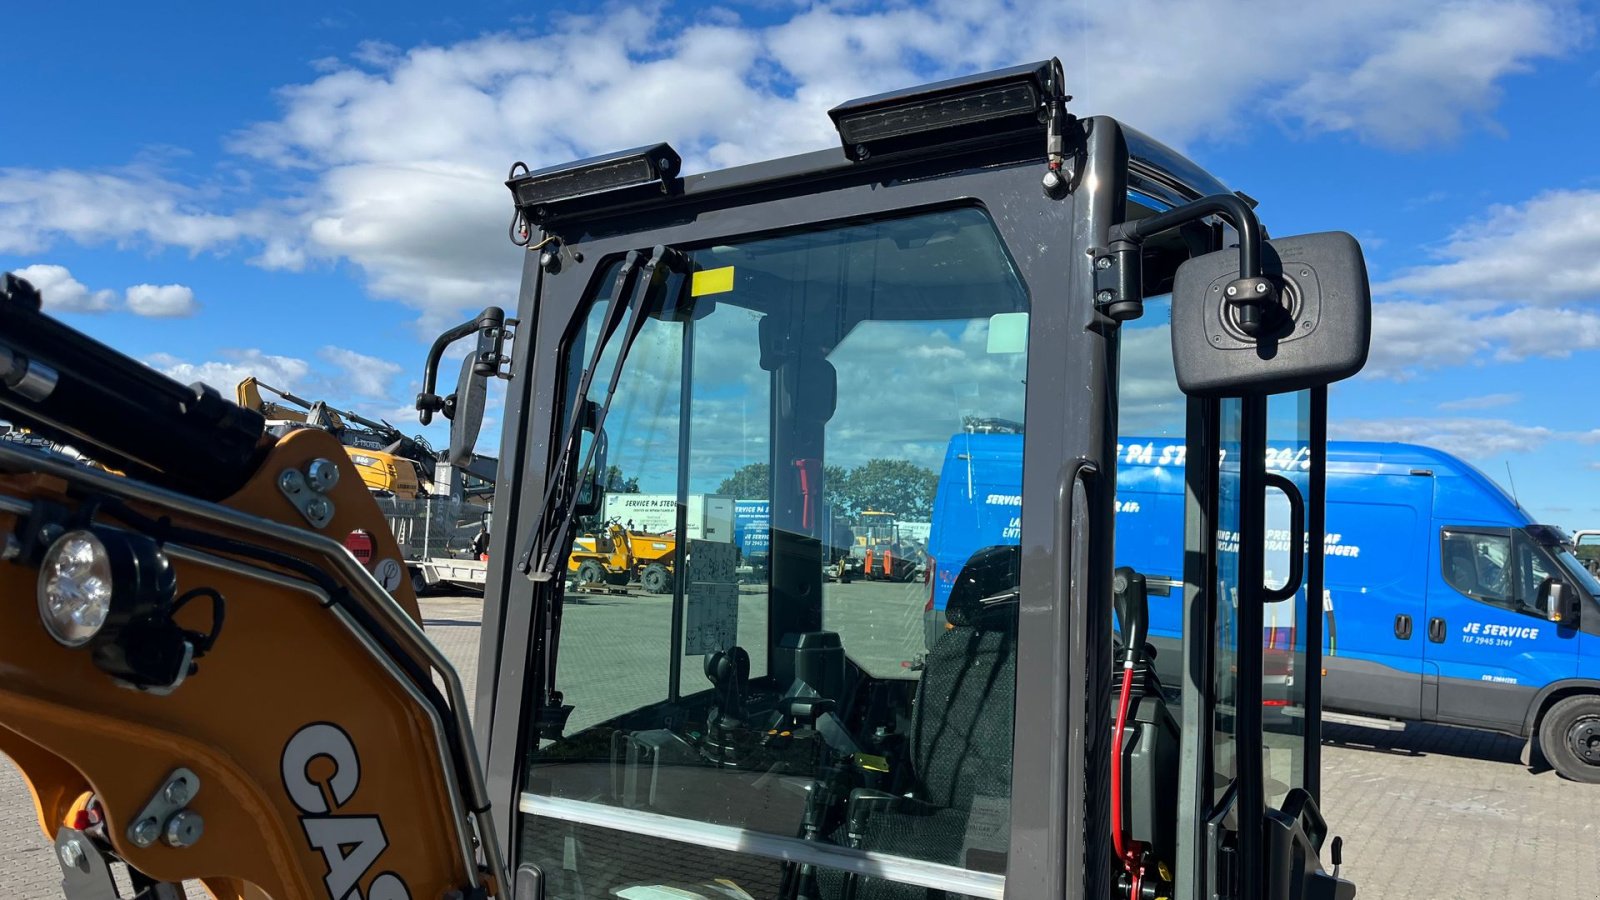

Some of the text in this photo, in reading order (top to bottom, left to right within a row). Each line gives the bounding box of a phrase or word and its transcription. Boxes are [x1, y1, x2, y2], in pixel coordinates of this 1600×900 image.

[1463, 622, 1539, 639] JE SERVICE
[1463, 635, 1473, 643] TLF
[1474, 636, 1494, 645] 2945
